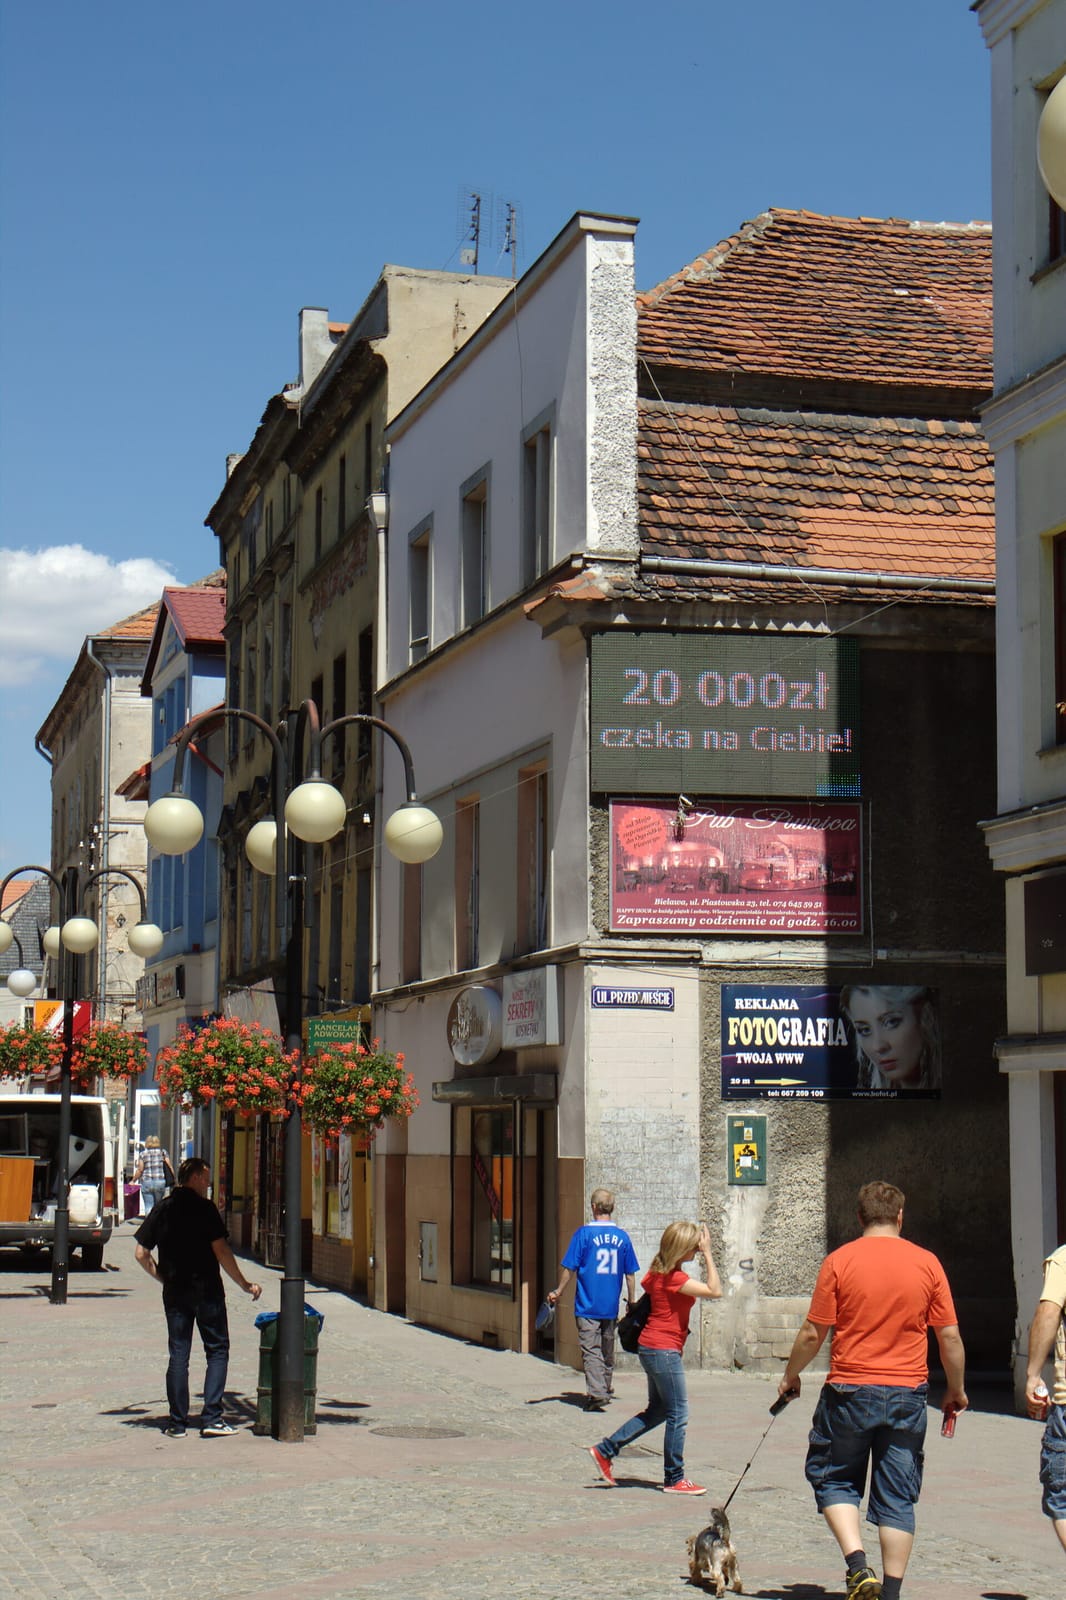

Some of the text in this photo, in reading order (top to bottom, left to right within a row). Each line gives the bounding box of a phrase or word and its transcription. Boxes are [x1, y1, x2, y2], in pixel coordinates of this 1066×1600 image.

[622, 668, 830, 710] 20 000zł
[600, 721, 853, 753] czeka na Ciebie!
[669, 806, 857, 832] Pub Piwnica
[654, 898, 688, 907] Bielawa,
[689, 898, 699, 906] ul.
[759, 899, 771, 907] tel.
[773, 900, 787, 908] 074
[617, 914, 857, 928] Zapraszamy codziennie od godz. 16.00
[734, 998, 799, 1010] REKLAMA
[314, 1031, 358, 1039] ADWOKAC
[727, 1017, 848, 1047] FOTOGRAFIA
[735, 1052, 804, 1064] TWOJA WWW
[593, 1233, 623, 1247] VIERI
[596, 1248, 618, 1274] 21
